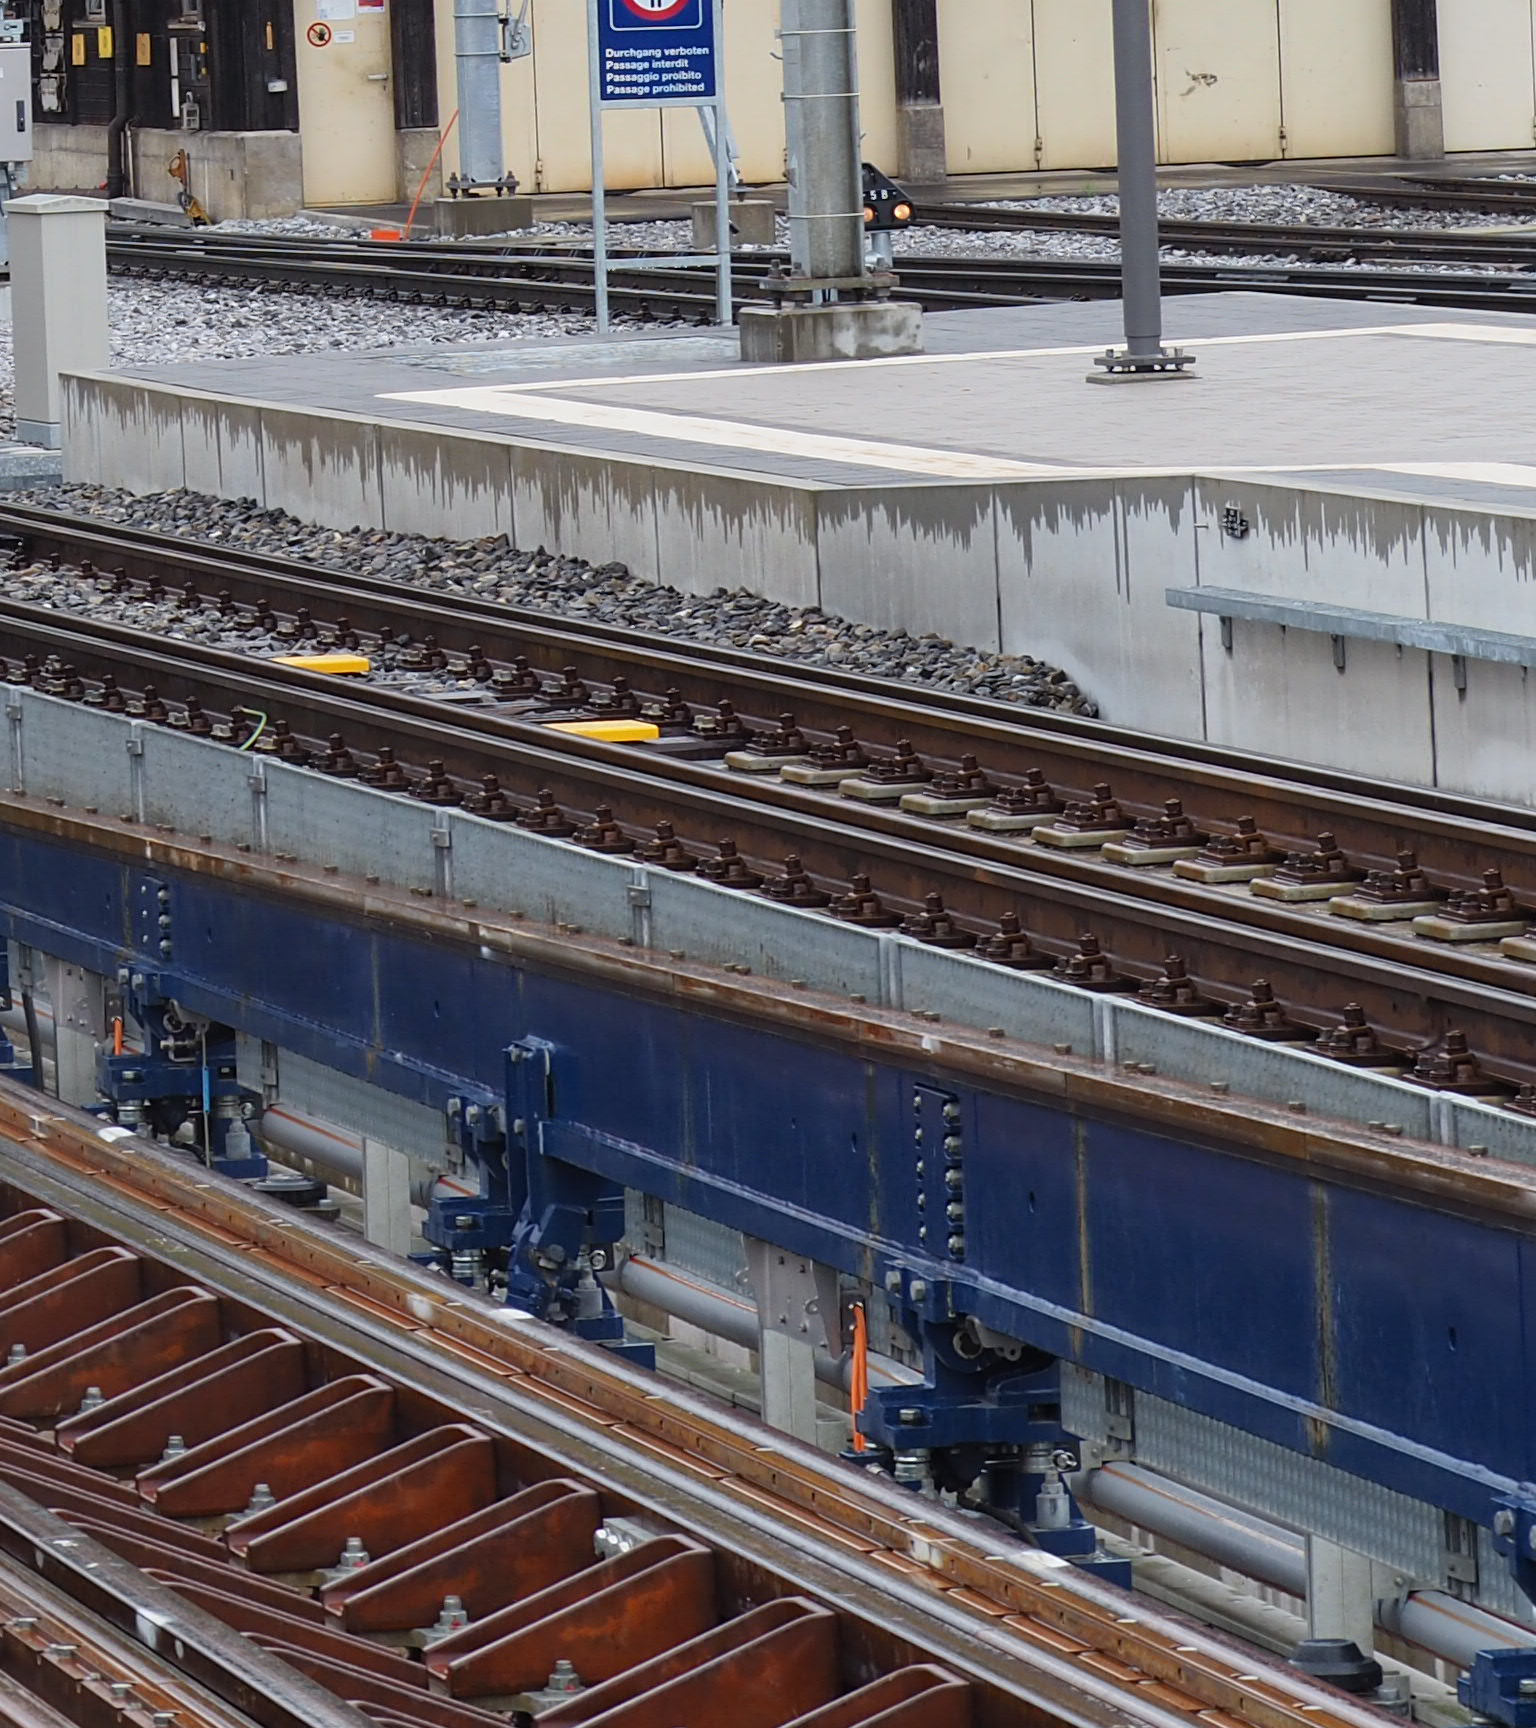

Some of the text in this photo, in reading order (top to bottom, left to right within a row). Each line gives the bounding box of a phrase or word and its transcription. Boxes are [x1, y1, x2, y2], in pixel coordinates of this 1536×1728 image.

[605, 46, 710, 59] Durchgang verboten
[605, 59, 689, 71] Passage interdit
[606, 71, 702, 84] Passaggio proibito
[606, 82, 705, 96] Passage prohibited
